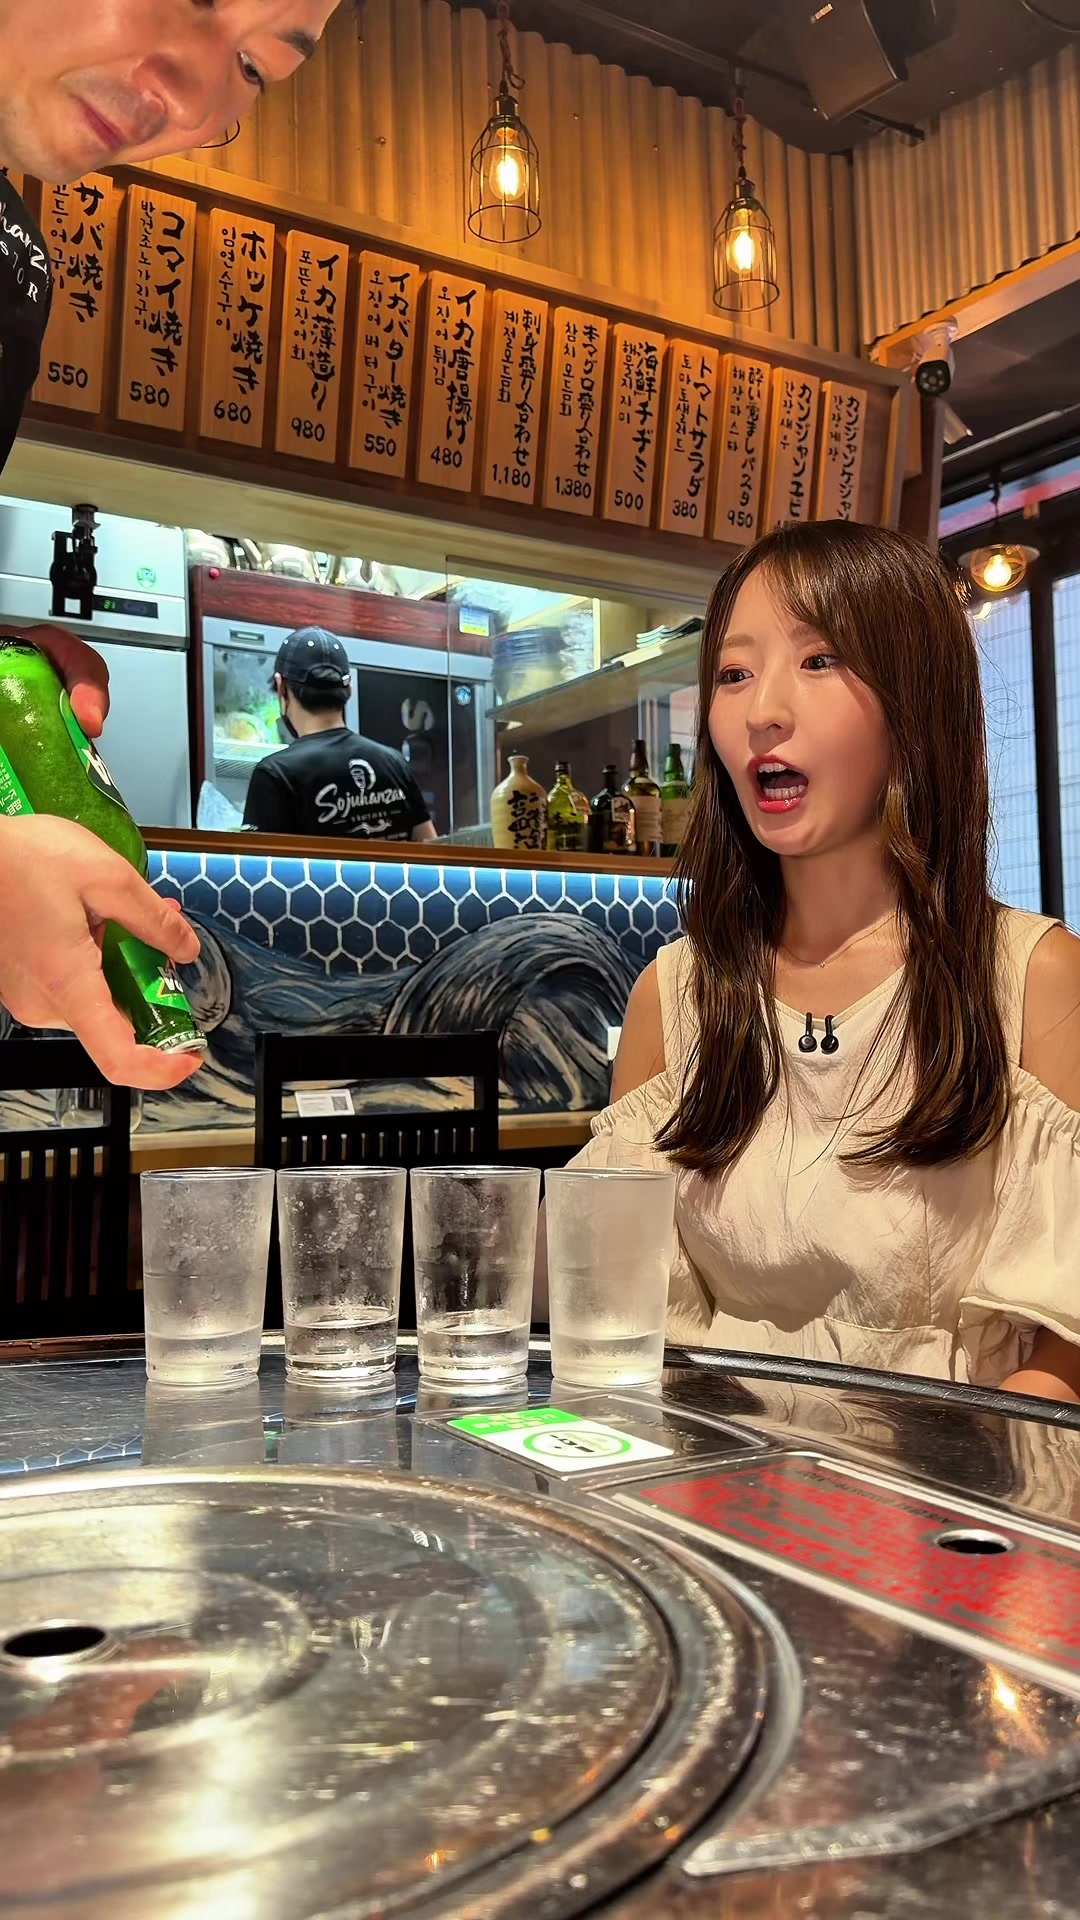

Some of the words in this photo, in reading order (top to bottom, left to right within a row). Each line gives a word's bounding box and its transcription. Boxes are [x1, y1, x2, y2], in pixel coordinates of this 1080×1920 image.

[66, 182, 105, 323] サバ焼き
[148, 211, 186, 377] コマイ焼き
[215, 226, 237, 332] 임연수구이
[230, 230, 267, 395] ホッケ焼き
[307, 254, 340, 412] イカ薄造り
[362, 270, 385, 411] 오징어버터구이
[377, 272, 411, 429] イカバター焼き
[432, 286, 451, 386] 오징어튀김
[47, 361, 88, 389] 550
[129, 381, 170, 408] 580
[213, 399, 252, 425] 680
[446, 289, 477, 445] イカ唐揚げ
[513, 309, 541, 467] 刺身盛り合わせ
[575, 325, 600, 478] 本マグロ盛り合わせ
[632, 341, 659, 484] 海鮮チヂミ
[674, 354, 692, 453] 토마토샐러드
[290, 417, 326, 442] 980
[364, 433, 397, 458] 550
[430, 446, 463, 469] 480
[492, 463, 531, 489] 1,180
[687, 356, 712, 498] トマトサラダ
[554, 476, 592, 499] 1,380
[614, 489, 644, 511] 500
[672, 499, 698, 520] 380
[727, 510, 753, 528] 950
